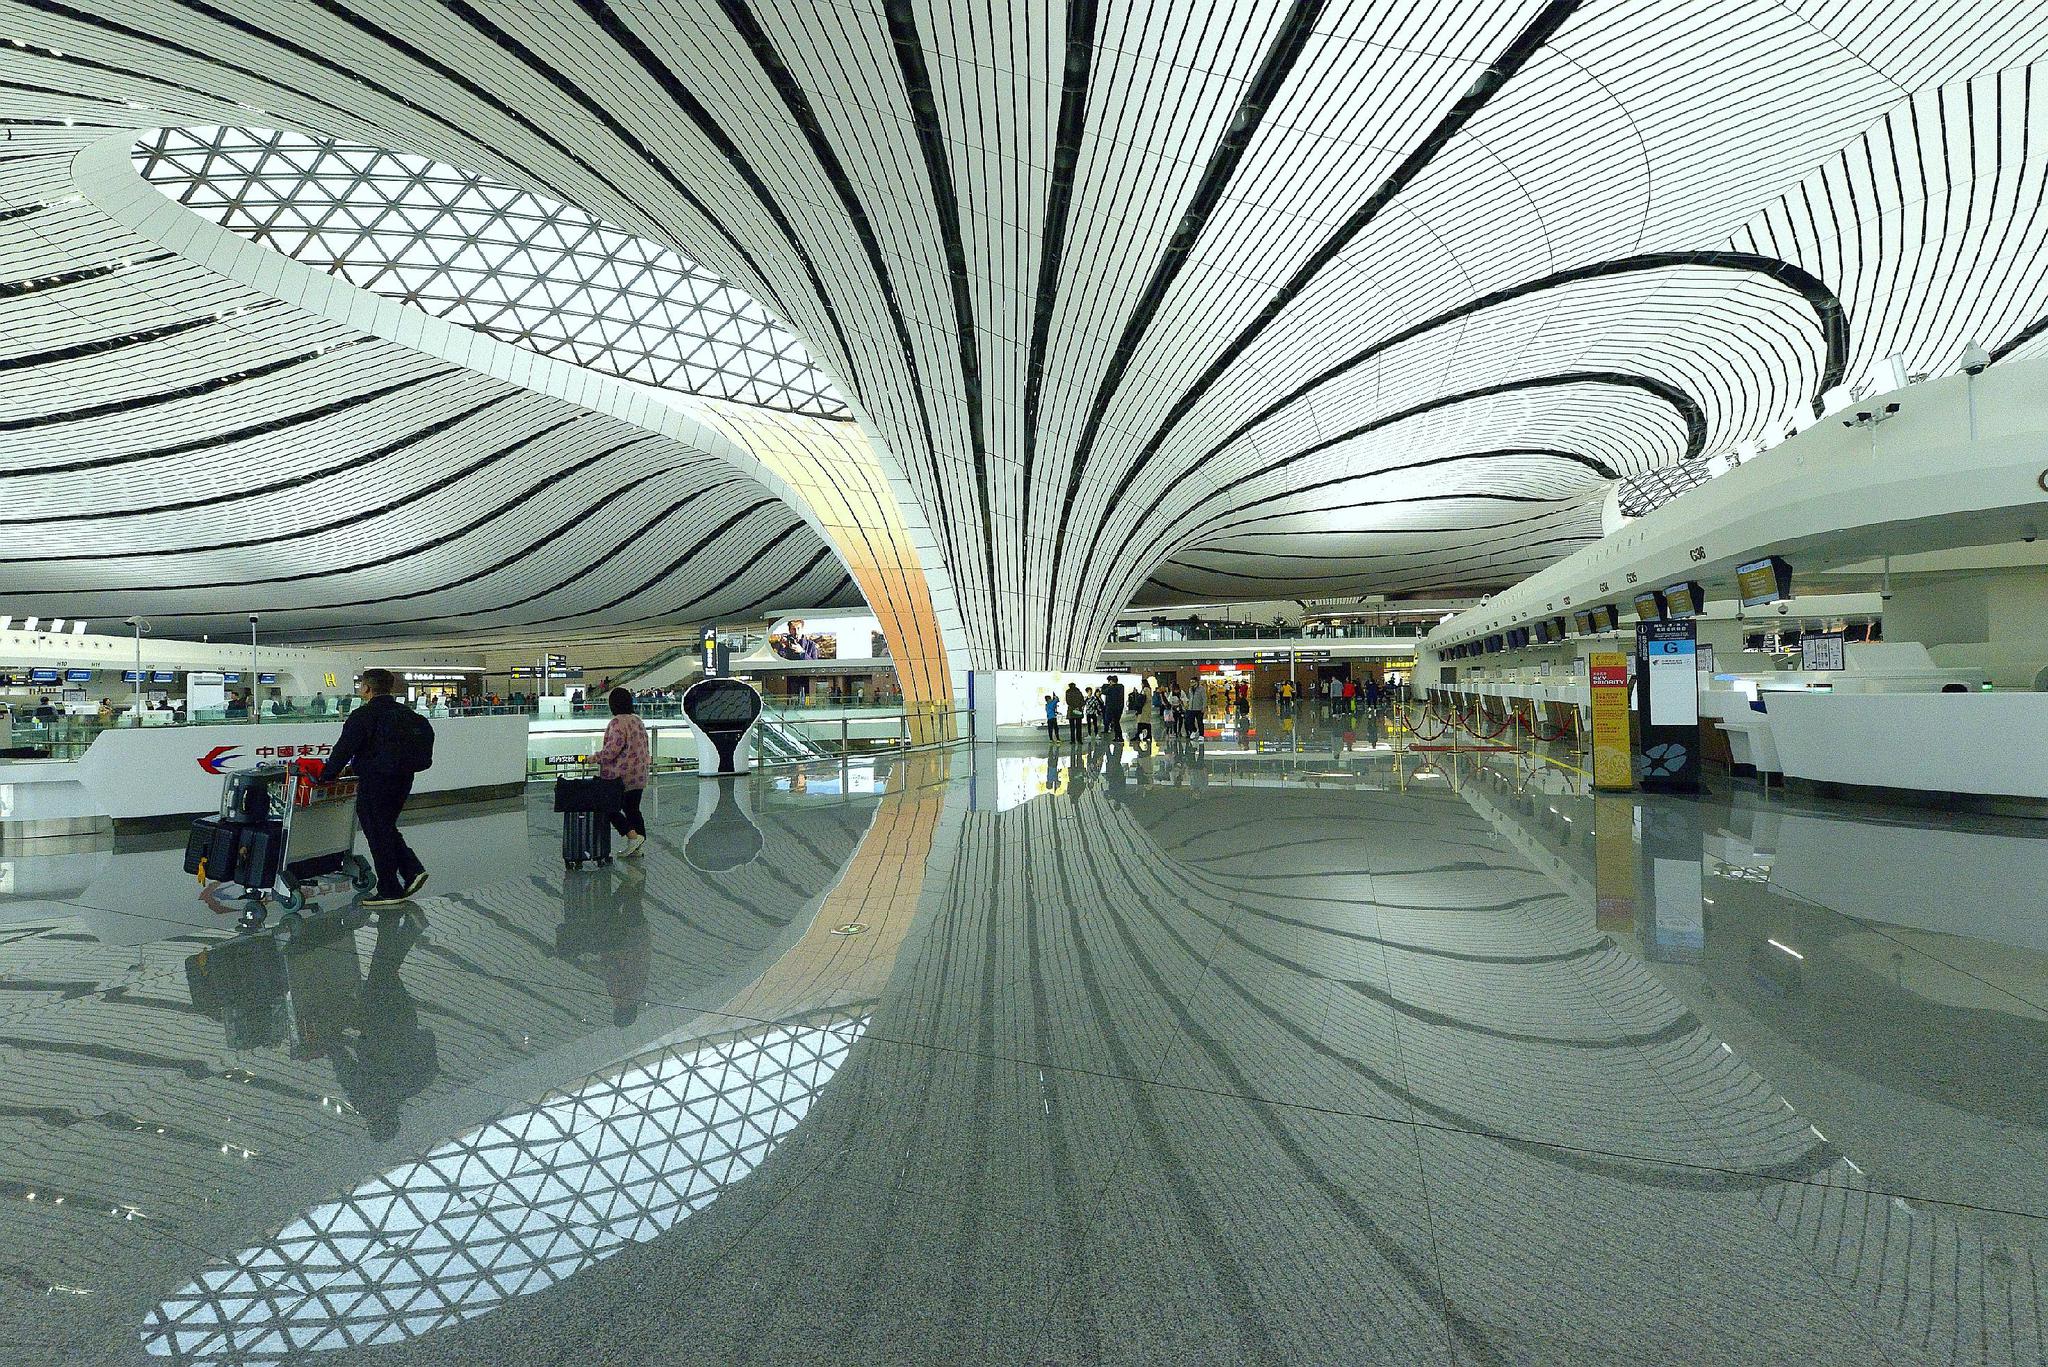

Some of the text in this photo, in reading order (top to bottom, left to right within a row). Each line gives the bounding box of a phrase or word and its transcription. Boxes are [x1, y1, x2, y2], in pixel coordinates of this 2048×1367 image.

[1690, 546, 1706, 561] G36
[1664, 642, 1678, 653] G
[324, 671, 337, 687] H
[256, 744, 332, 758] 中國東方
